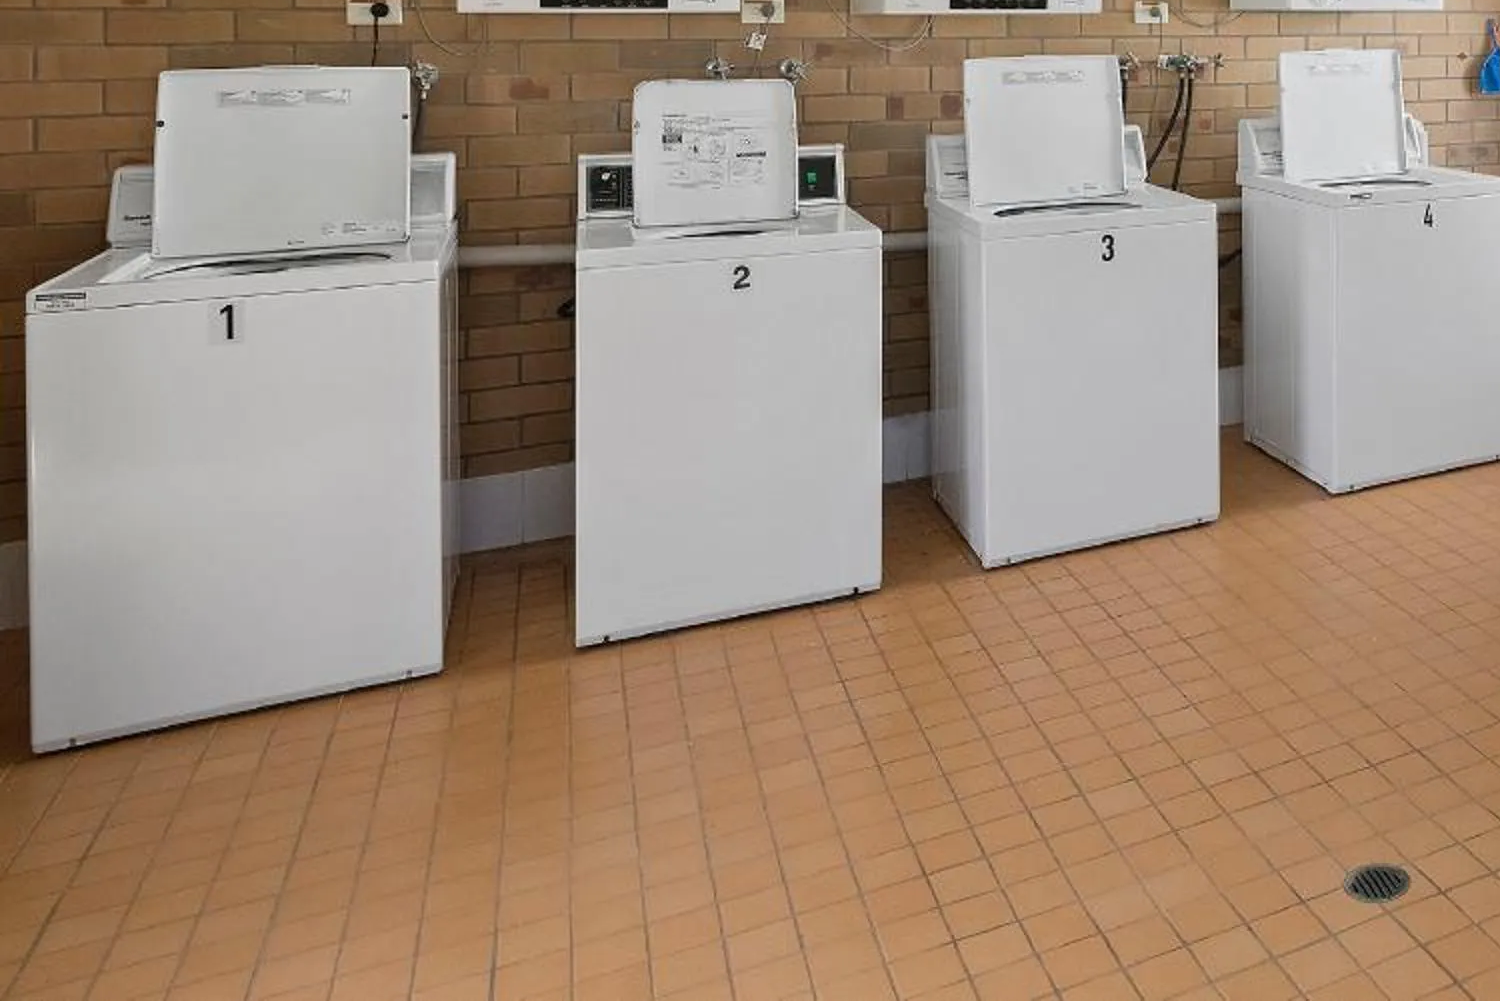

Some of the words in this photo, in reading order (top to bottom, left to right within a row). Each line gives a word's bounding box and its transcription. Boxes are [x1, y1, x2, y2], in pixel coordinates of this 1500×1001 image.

[1423, 202, 1433, 228] 4
[1101, 234, 1115, 262] 3
[733, 265, 751, 290] 2
[219, 304, 234, 340] 1
